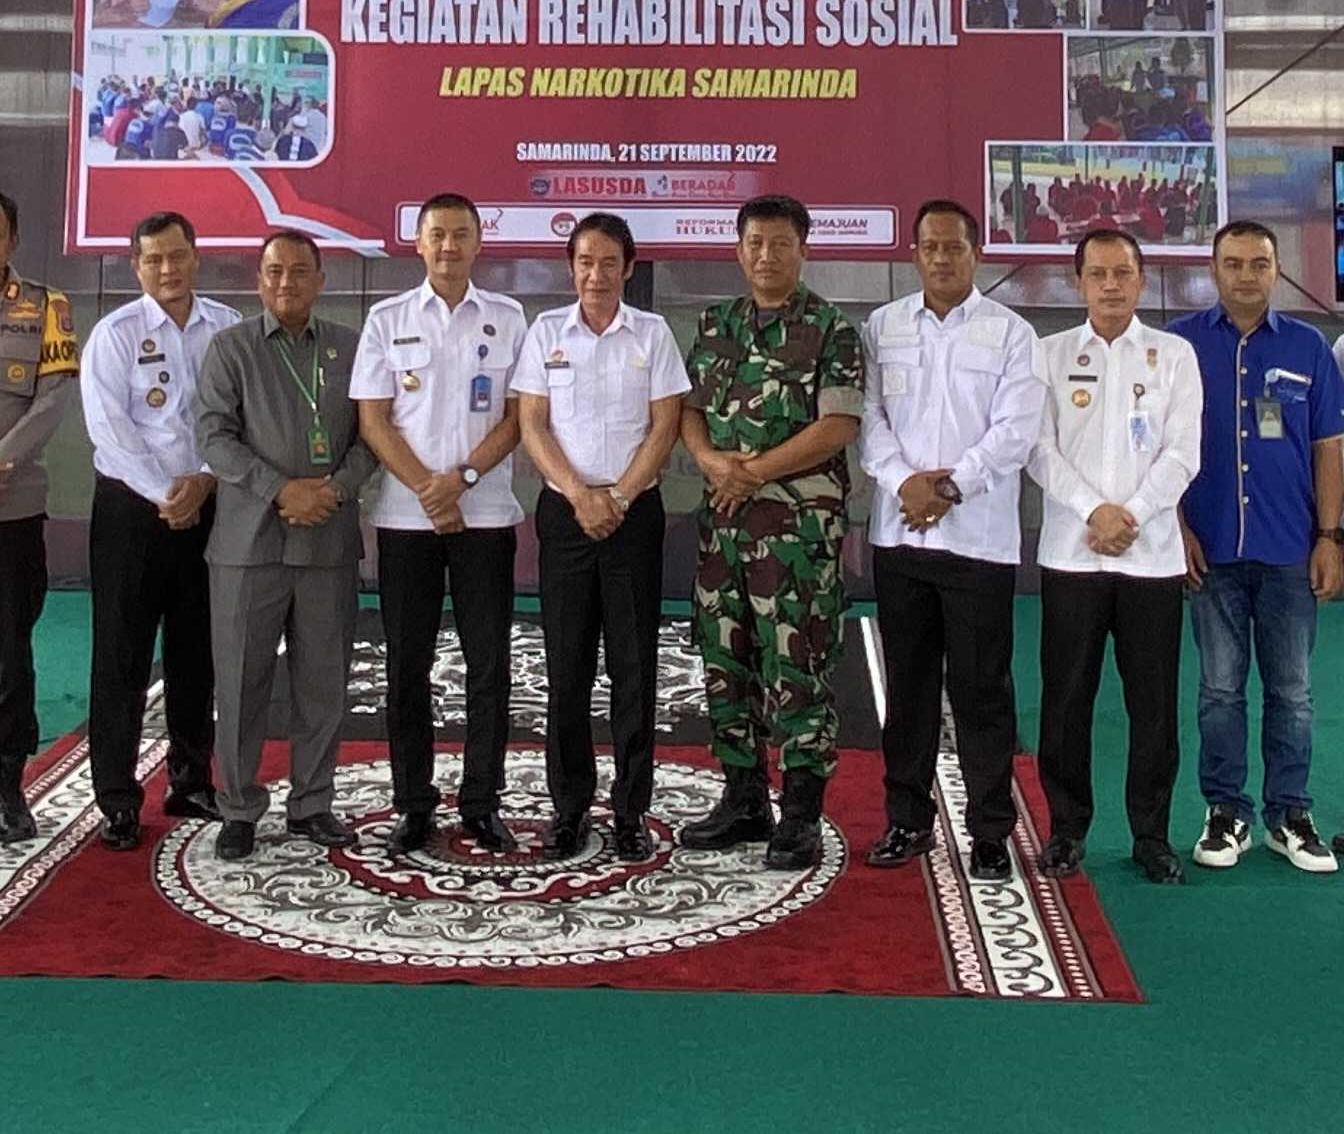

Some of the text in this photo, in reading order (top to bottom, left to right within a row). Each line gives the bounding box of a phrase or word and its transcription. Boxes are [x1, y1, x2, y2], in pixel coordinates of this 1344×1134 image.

[439, 66, 858, 99] LAPAS NARKOTIKA SAMARINDA
[516, 142, 777, 163] SAMARINDA, 21 SEPTEMBER 2022
[553, 176, 647, 195] LASUSDA
